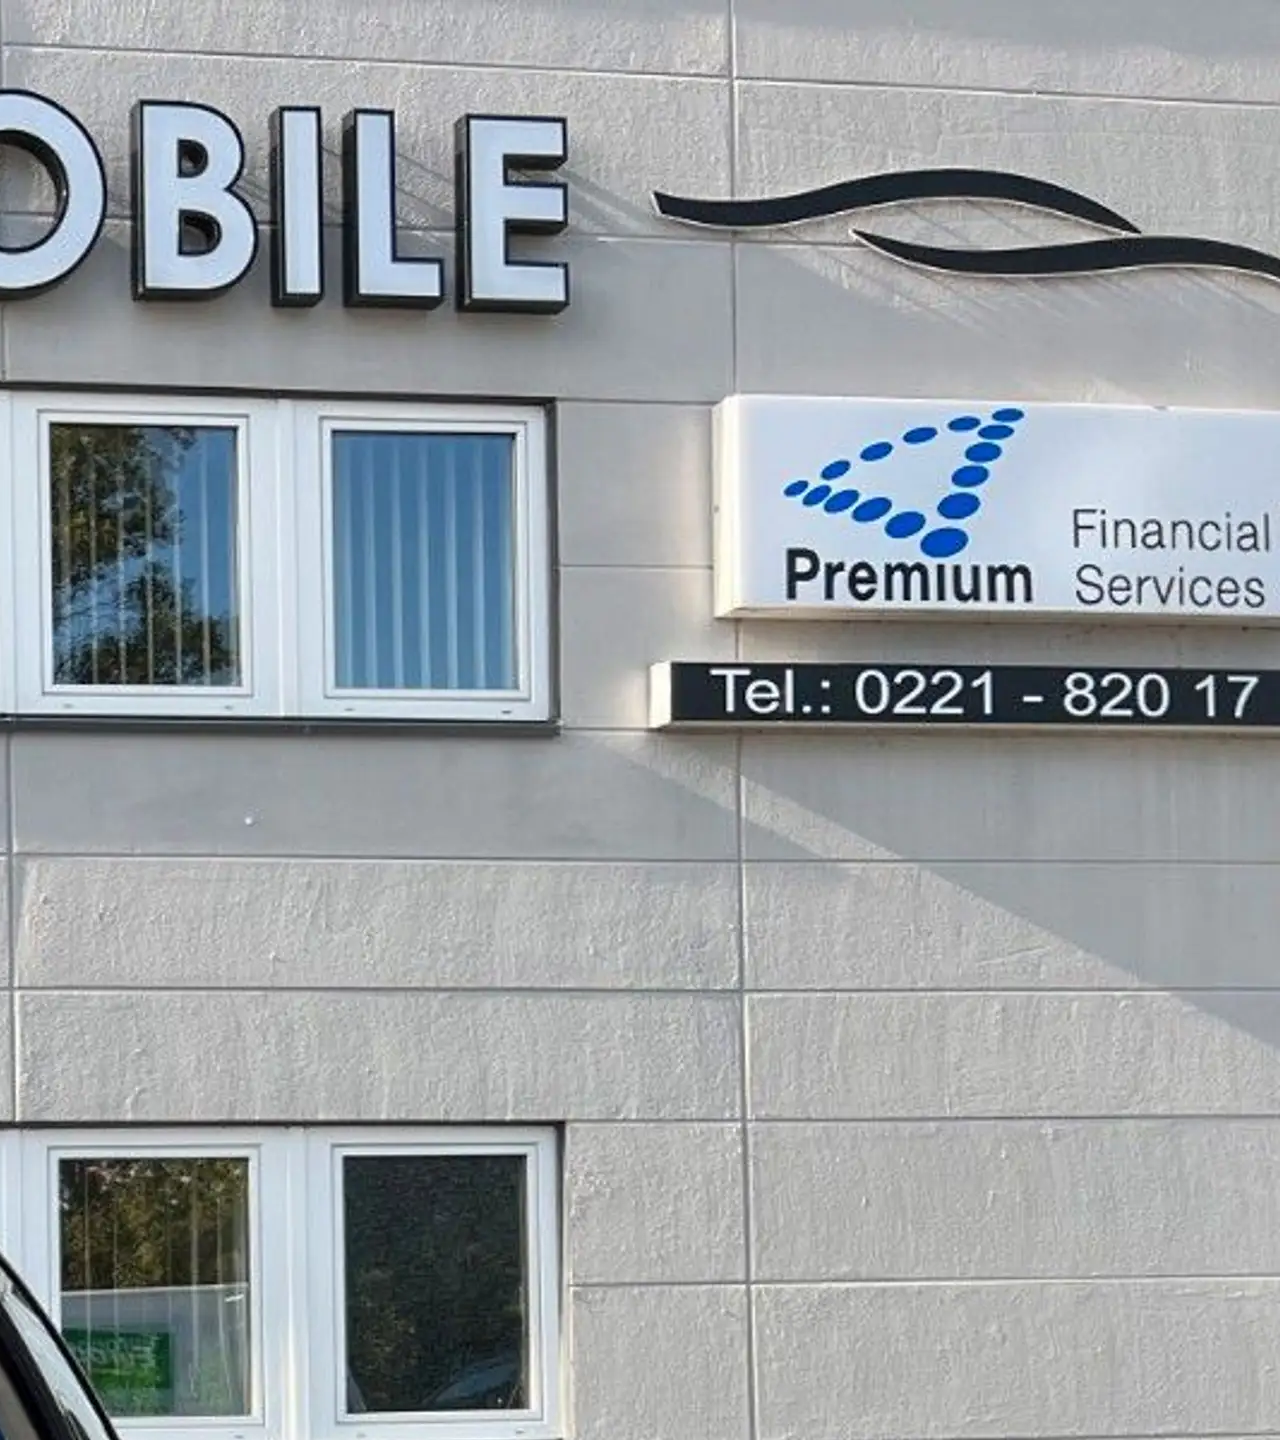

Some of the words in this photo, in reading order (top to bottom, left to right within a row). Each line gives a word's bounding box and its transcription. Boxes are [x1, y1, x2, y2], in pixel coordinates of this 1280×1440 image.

[1072, 508, 1270, 553] Financial
[785, 547, 1033, 603] Premium
[1075, 563, 1265, 608] Services
[709, 668, 831, 714] Tel.:
[854, 668, 993, 715] 0221
[1063, 671, 1170, 717] 820
[1194, 674, 1260, 719] 17
